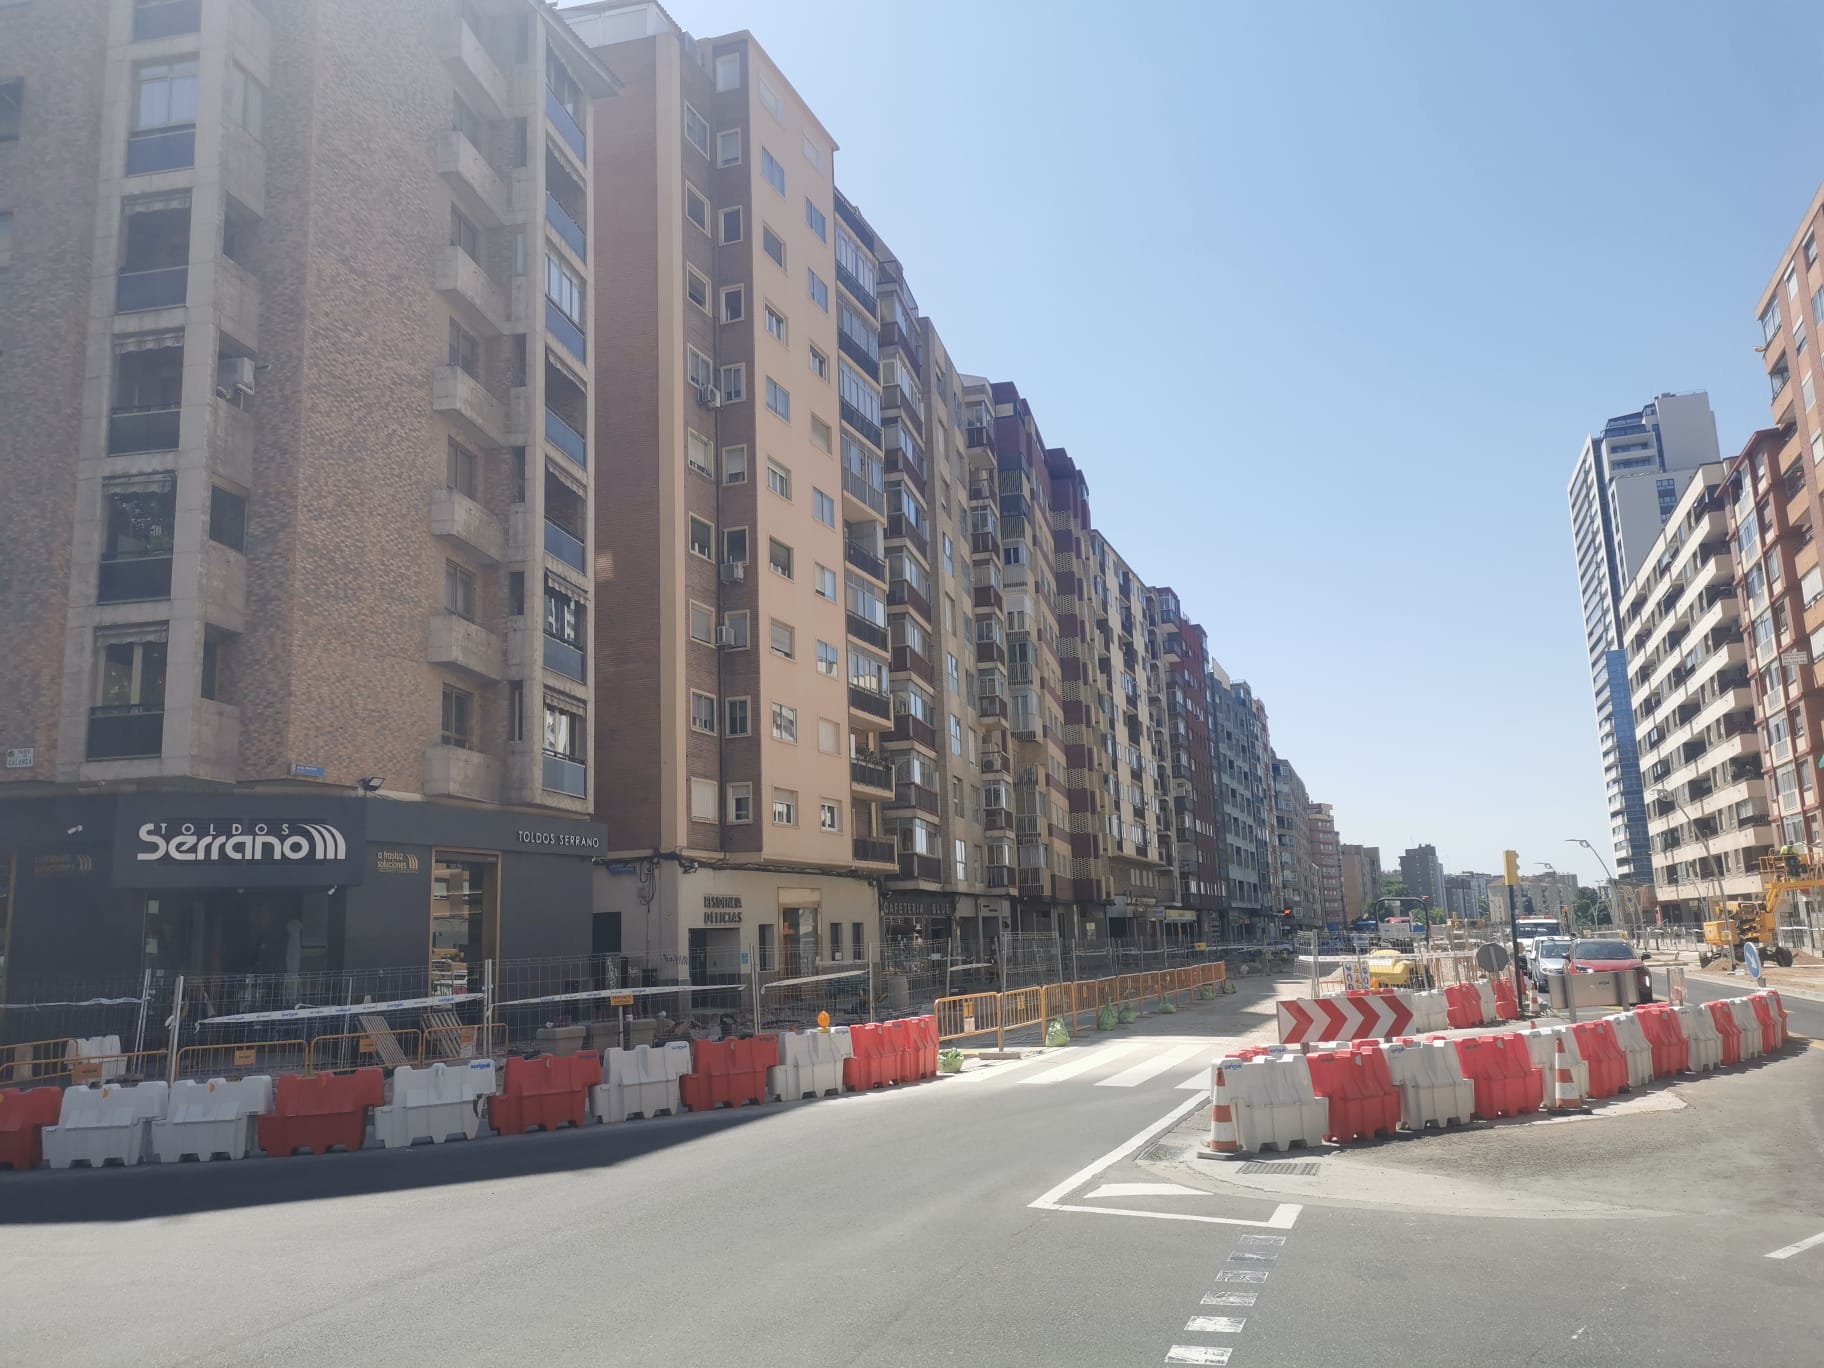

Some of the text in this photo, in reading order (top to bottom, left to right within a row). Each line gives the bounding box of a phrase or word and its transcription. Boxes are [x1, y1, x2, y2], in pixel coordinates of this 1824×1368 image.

[159, 823, 290, 835] TOLDOS
[136, 823, 310, 861] Serrano
[518, 831, 600, 848] TOLDOS SERRANO
[883, 902, 924, 914] CAFETERIA
[703, 911, 743, 924] DELICIAS
